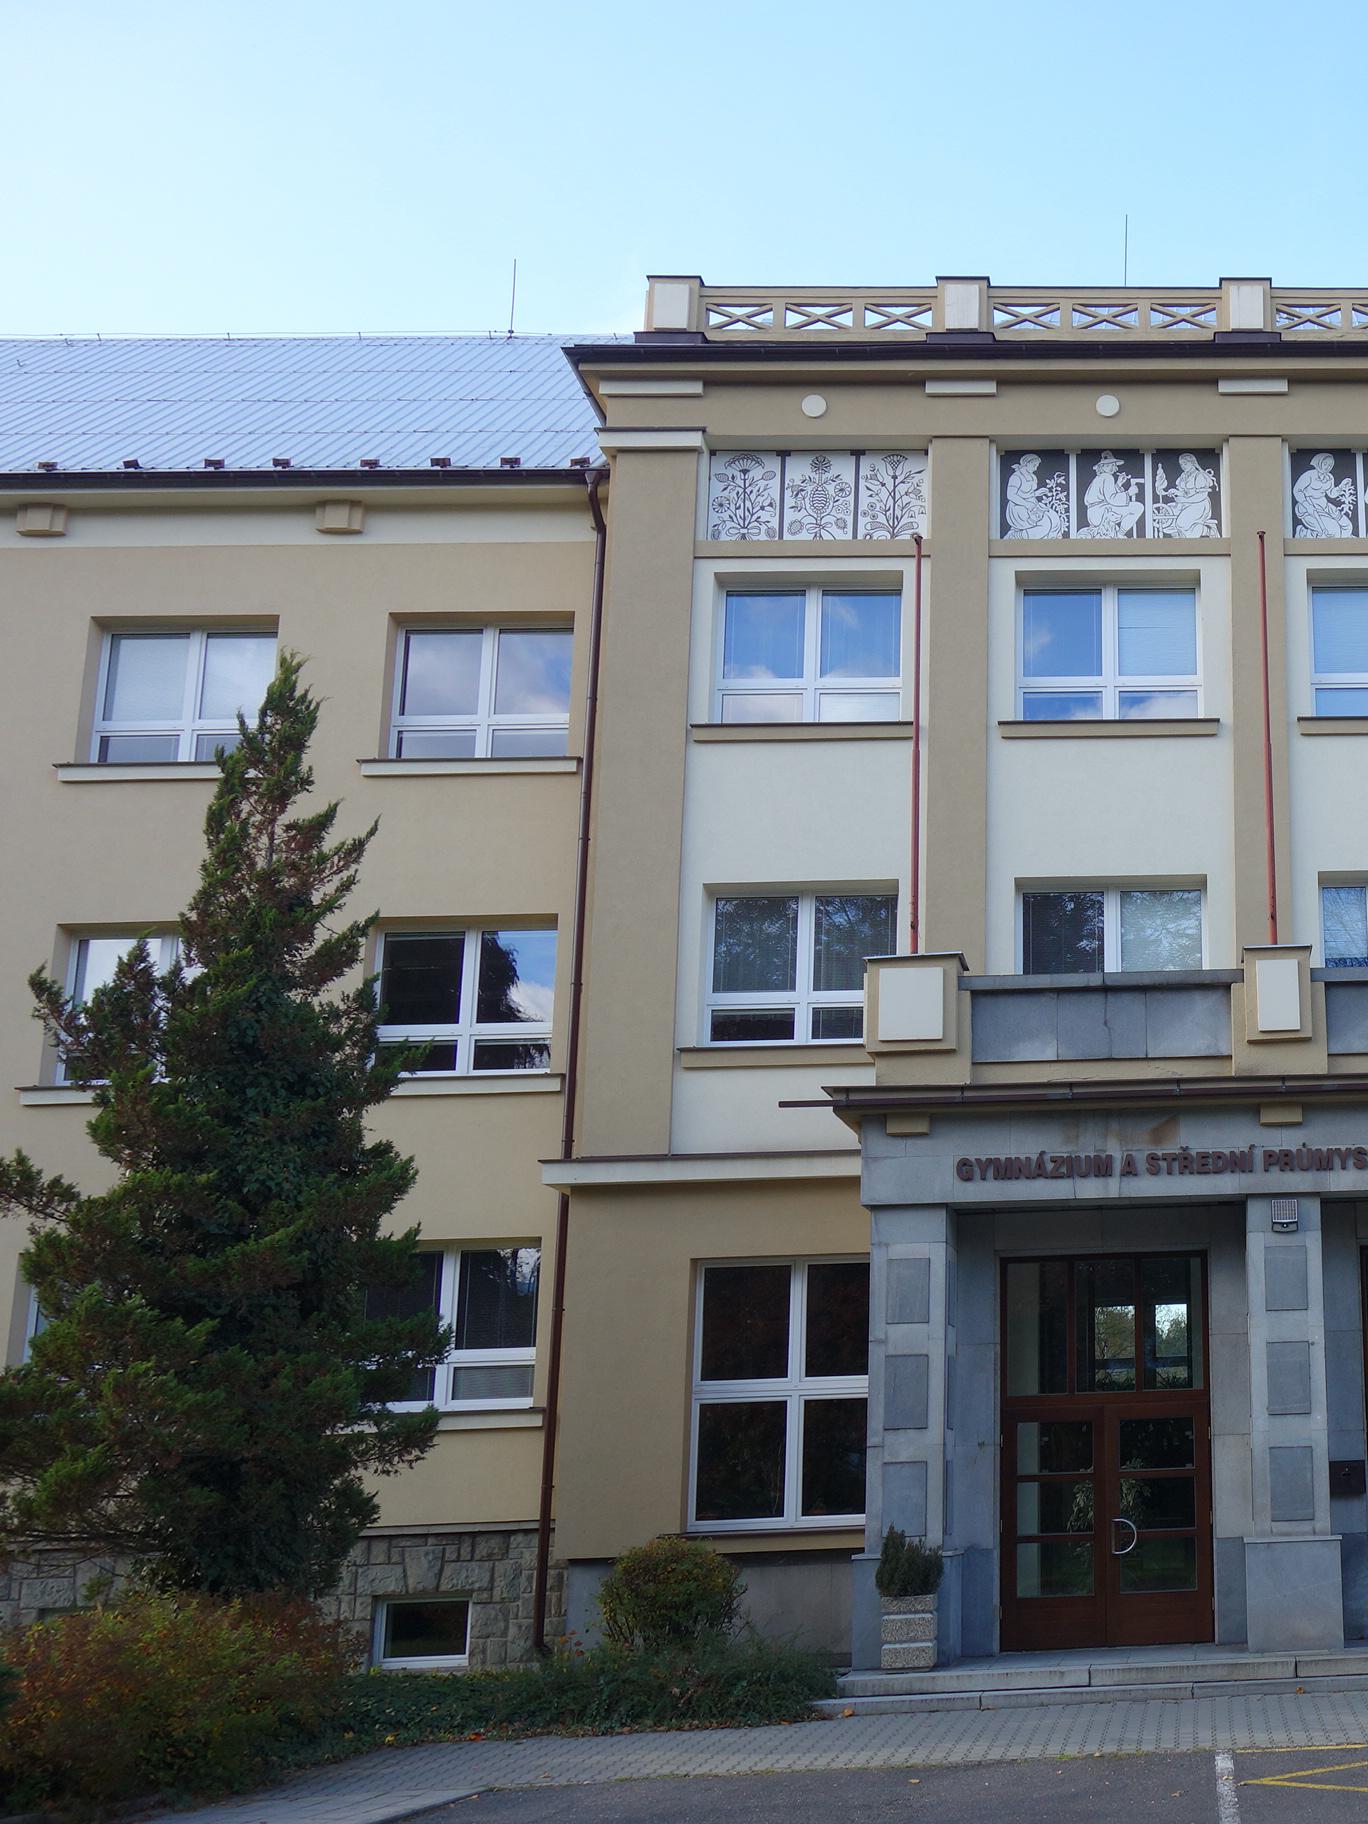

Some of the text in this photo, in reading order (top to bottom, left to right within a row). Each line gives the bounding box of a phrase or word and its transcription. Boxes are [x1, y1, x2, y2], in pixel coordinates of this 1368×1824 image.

[956, 1151, 1113, 1181] GYMNÁZIUM
[1120, 1154, 1138, 1178] A
[1146, 1145, 1256, 1176] STŘEDNÍ
